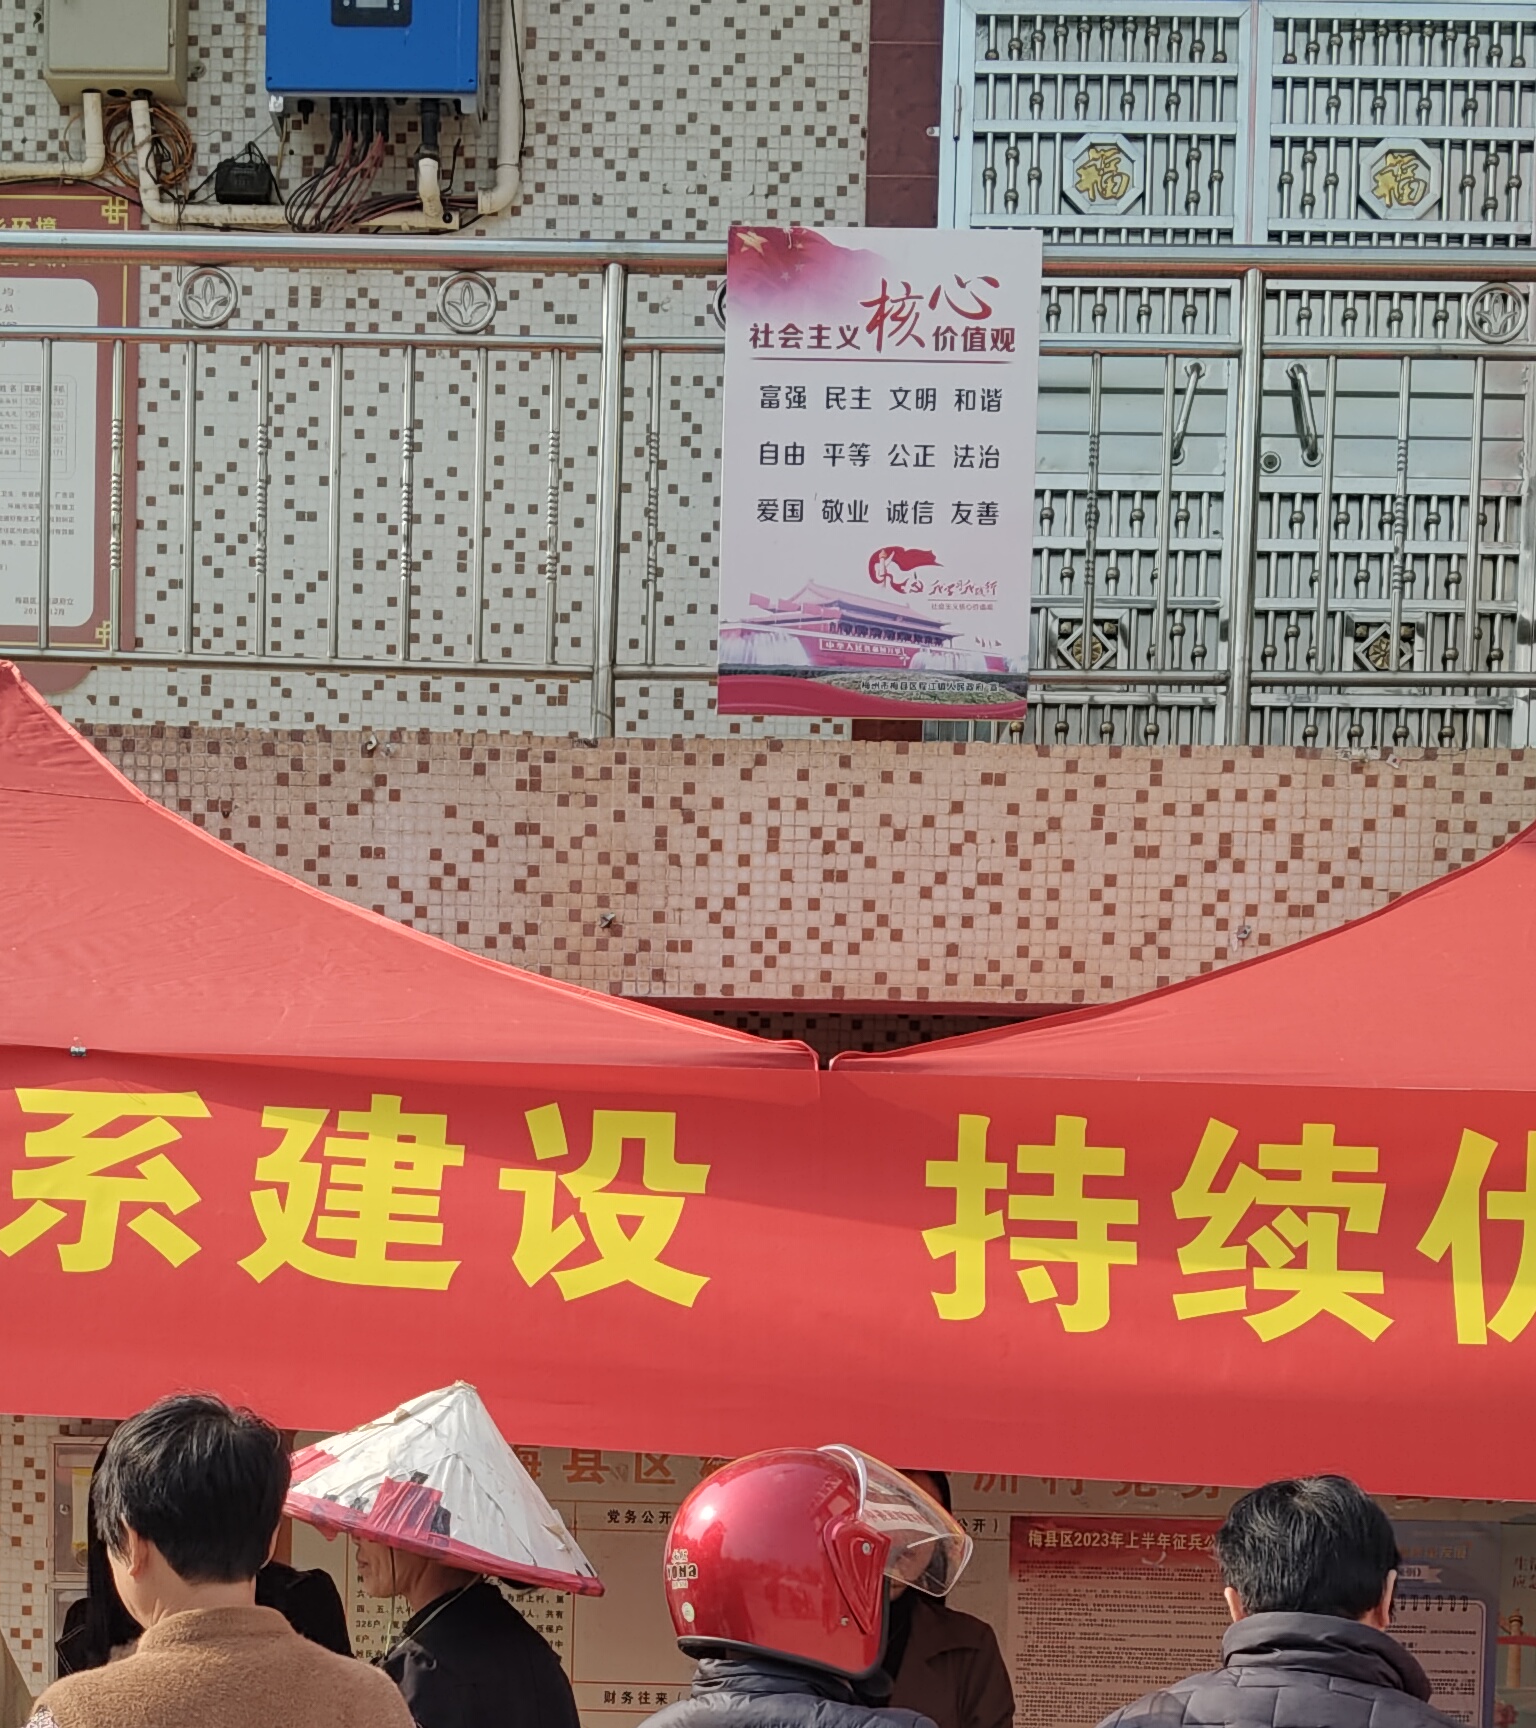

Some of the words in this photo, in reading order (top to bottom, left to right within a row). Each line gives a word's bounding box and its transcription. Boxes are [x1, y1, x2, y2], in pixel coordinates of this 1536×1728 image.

[749, 322, 860, 352] 社会主义
[859, 273, 1001, 354] 核心
[931, 325, 1016, 353] 价值观
[759, 384, 808, 411] 富强
[824, 385, 872, 411] 民主
[888, 386, 937, 412] 文明
[953, 386, 1003, 413] 和谐
[759, 441, 805, 467] 自由
[822, 441, 872, 468] 平等
[887, 443, 937, 469] 公正
[952, 443, 1001, 470] 法治
[756, 498, 805, 525] 爱国
[821, 498, 870, 525] 敬业
[886, 499, 935, 526] 诚信
[950, 500, 1001, 526] 友善
